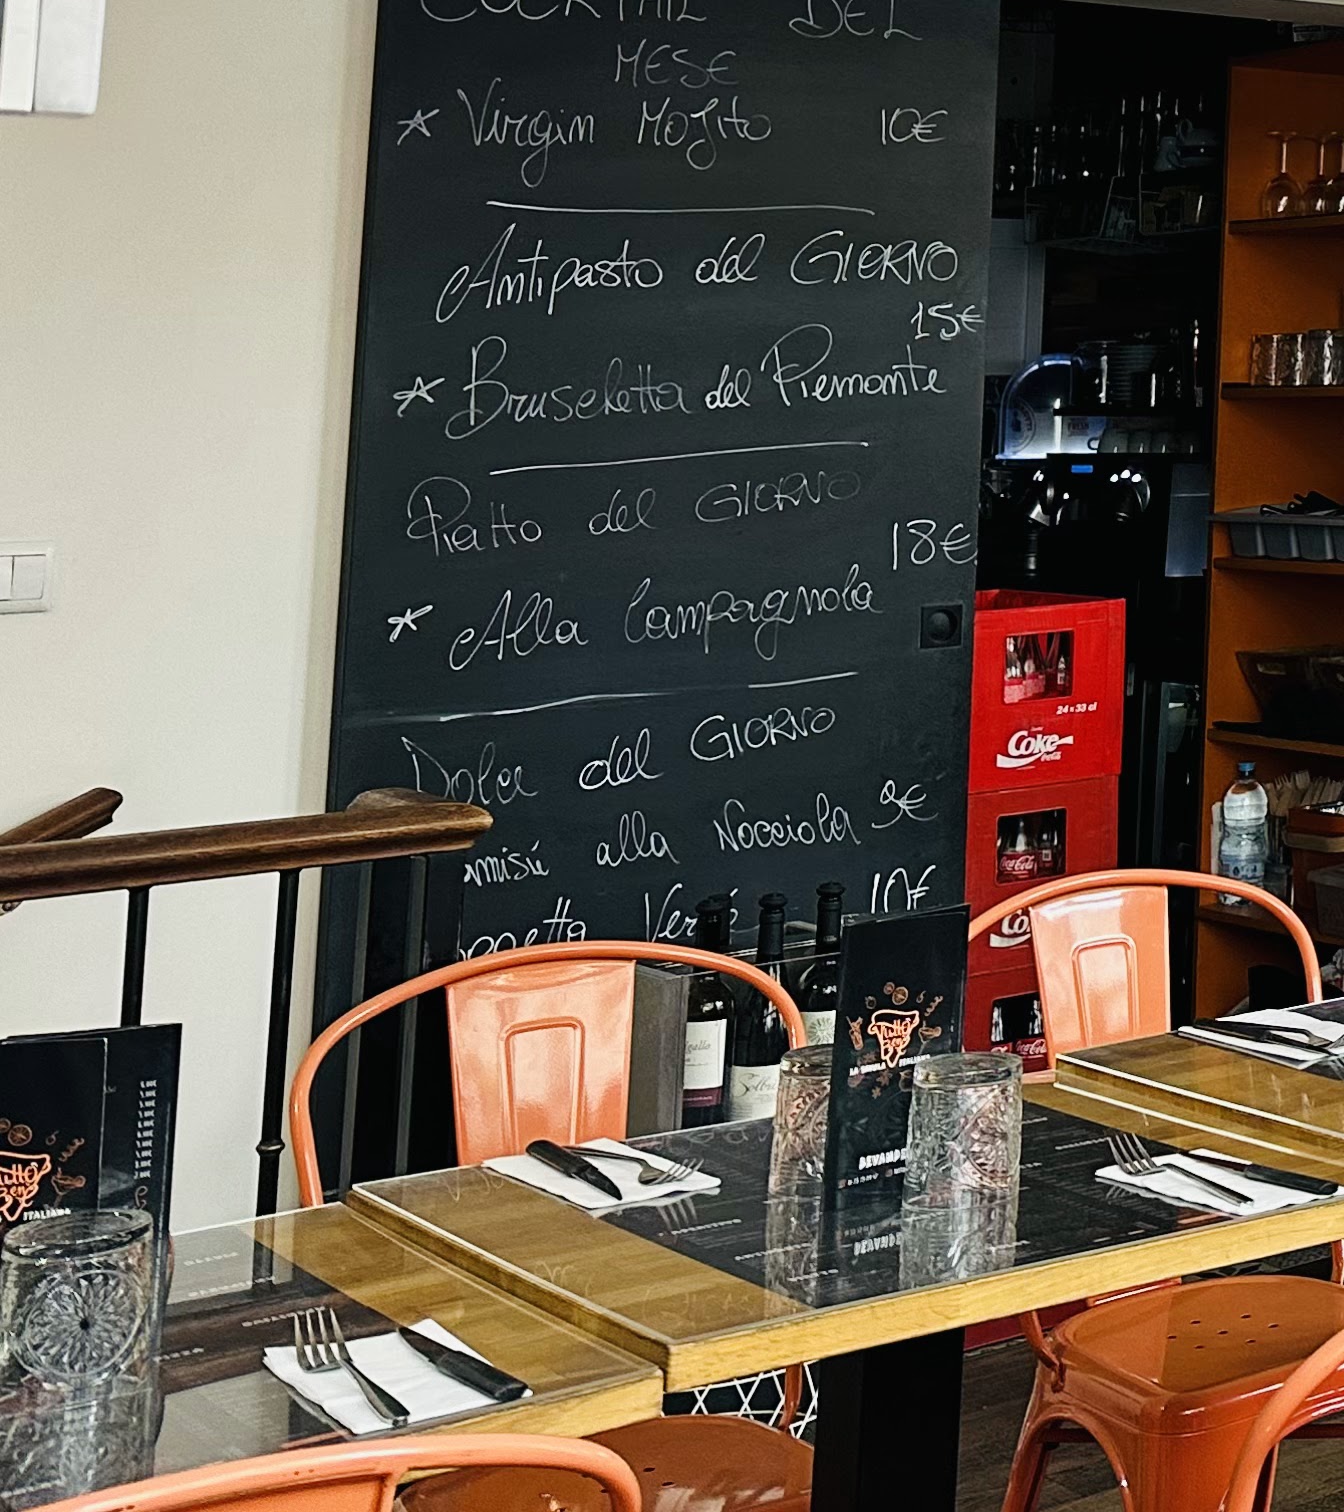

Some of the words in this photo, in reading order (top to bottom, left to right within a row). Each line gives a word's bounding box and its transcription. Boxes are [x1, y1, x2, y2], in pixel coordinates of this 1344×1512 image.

[615, 40, 740, 88] MESE
[457, 78, 595, 187] Virgin
[881, 108, 947, 143] 10€
[436, 223, 664, 323] Antipasto
[695, 233, 765, 284] del
[790, 231, 959, 285] GIORNO
[911, 302, 984, 341] 15€
[704, 365, 751, 409] del
[761, 324, 947, 406] Piemonte
[406, 476, 543, 556] Piatto
[589, 488, 656, 536] del
[695, 471, 862, 522] GIORNO
[891, 519, 978, 570] 18€
[624, 563, 882, 660] Campagnola
[578, 728, 664, 790] del
[690, 707, 837, 765] GIORNO
[1007, 730, 1060, 757] Coke
[597, 811, 680, 868] alla
[1001, 909, 1031, 936] Co
[0, 1161, 38, 1186] utto
